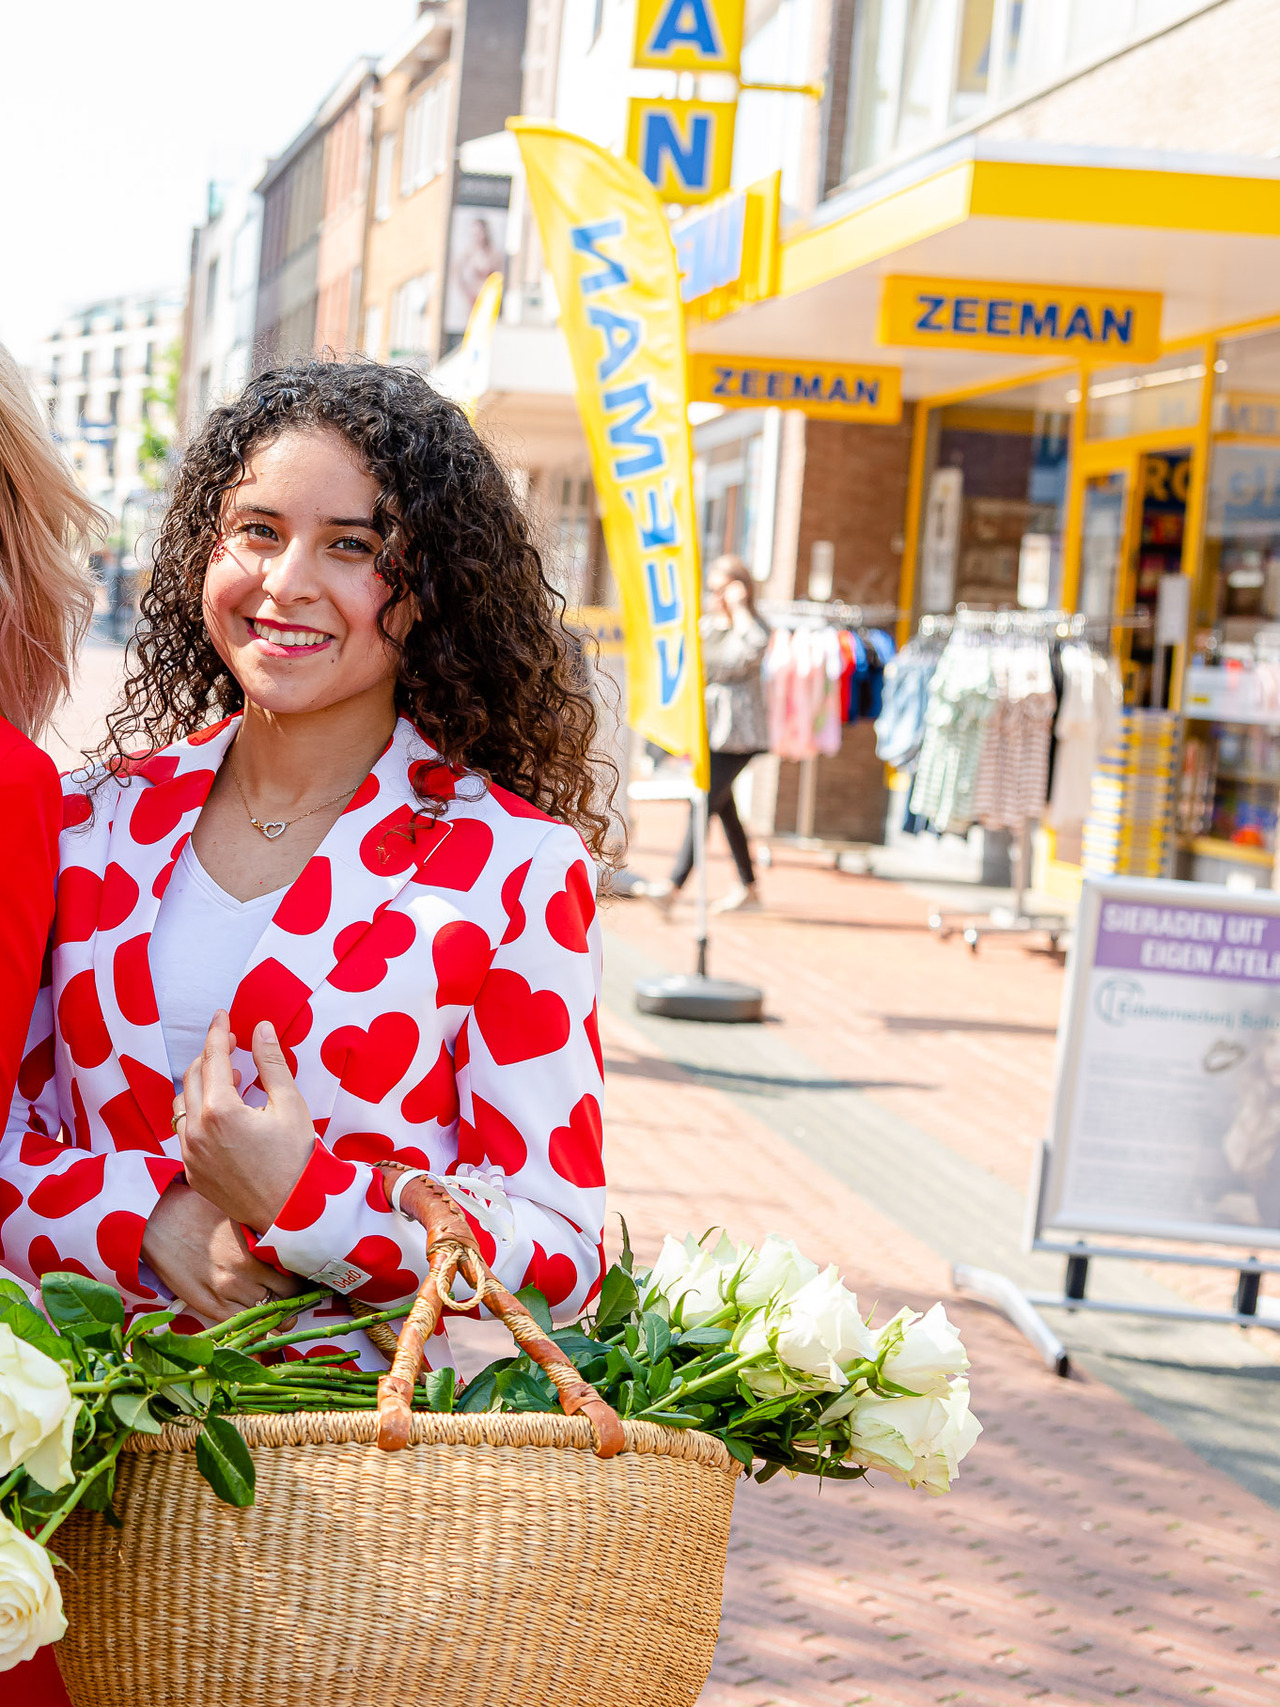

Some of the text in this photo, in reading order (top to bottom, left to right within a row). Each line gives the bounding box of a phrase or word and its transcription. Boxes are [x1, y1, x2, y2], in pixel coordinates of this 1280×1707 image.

[916, 295, 1133, 343] ZEEMAN
[713, 367, 879, 405] ZEEMAN
[1102, 904, 1268, 946] SIERADEN UIT
[1140, 938, 1214, 972] EIGEN
[332, 1269, 362, 1289] OPPO
